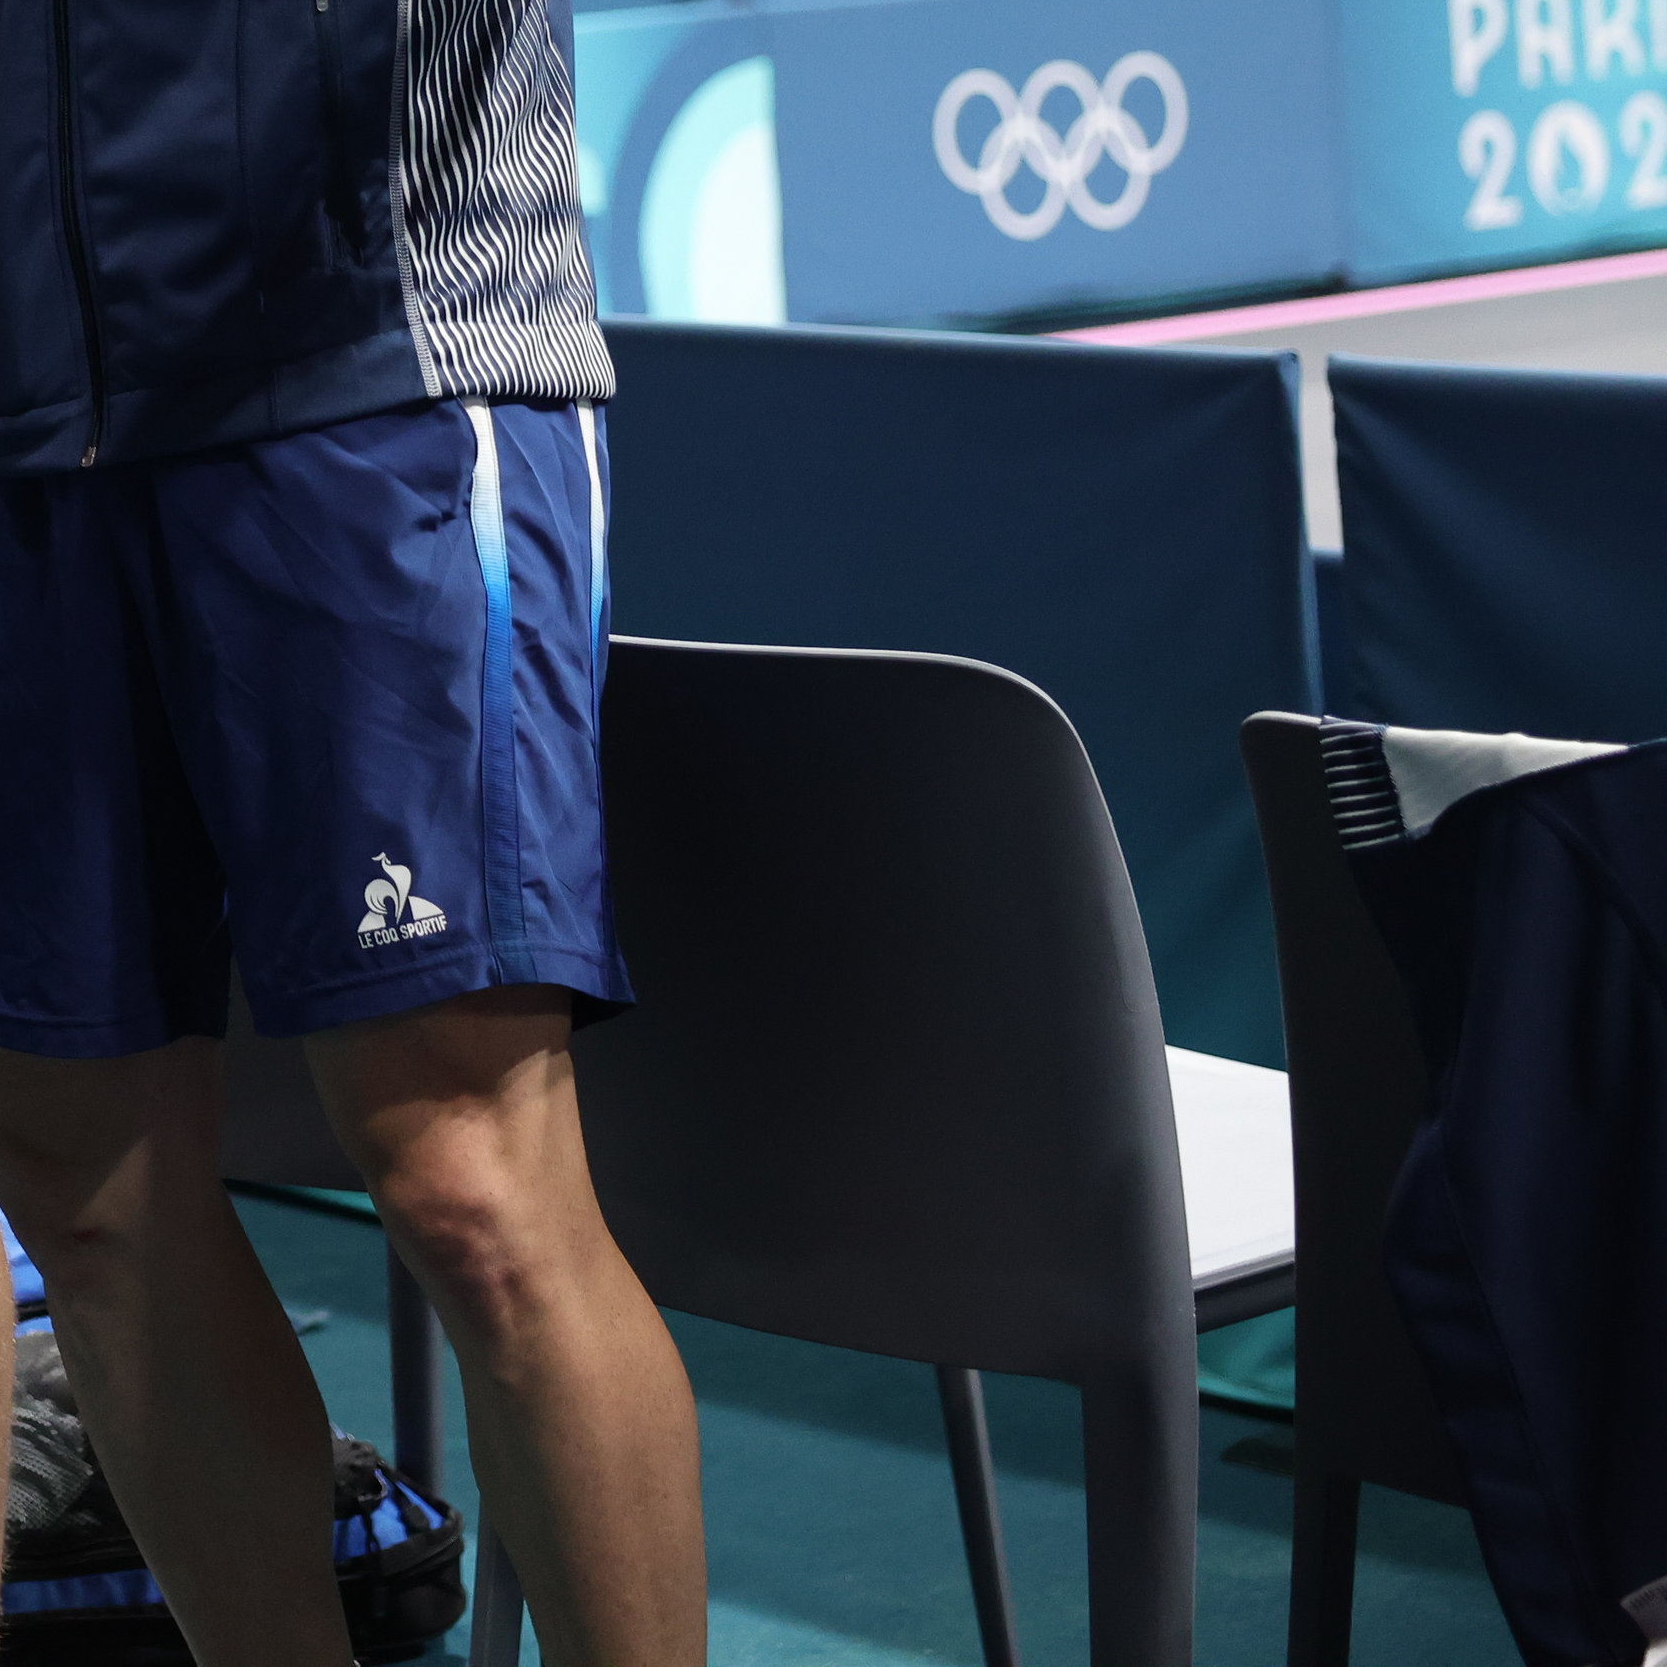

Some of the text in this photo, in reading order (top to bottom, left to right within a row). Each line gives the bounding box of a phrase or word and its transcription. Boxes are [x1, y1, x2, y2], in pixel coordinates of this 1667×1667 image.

[358, 915, 447, 949] LE COQ SPORTIF
